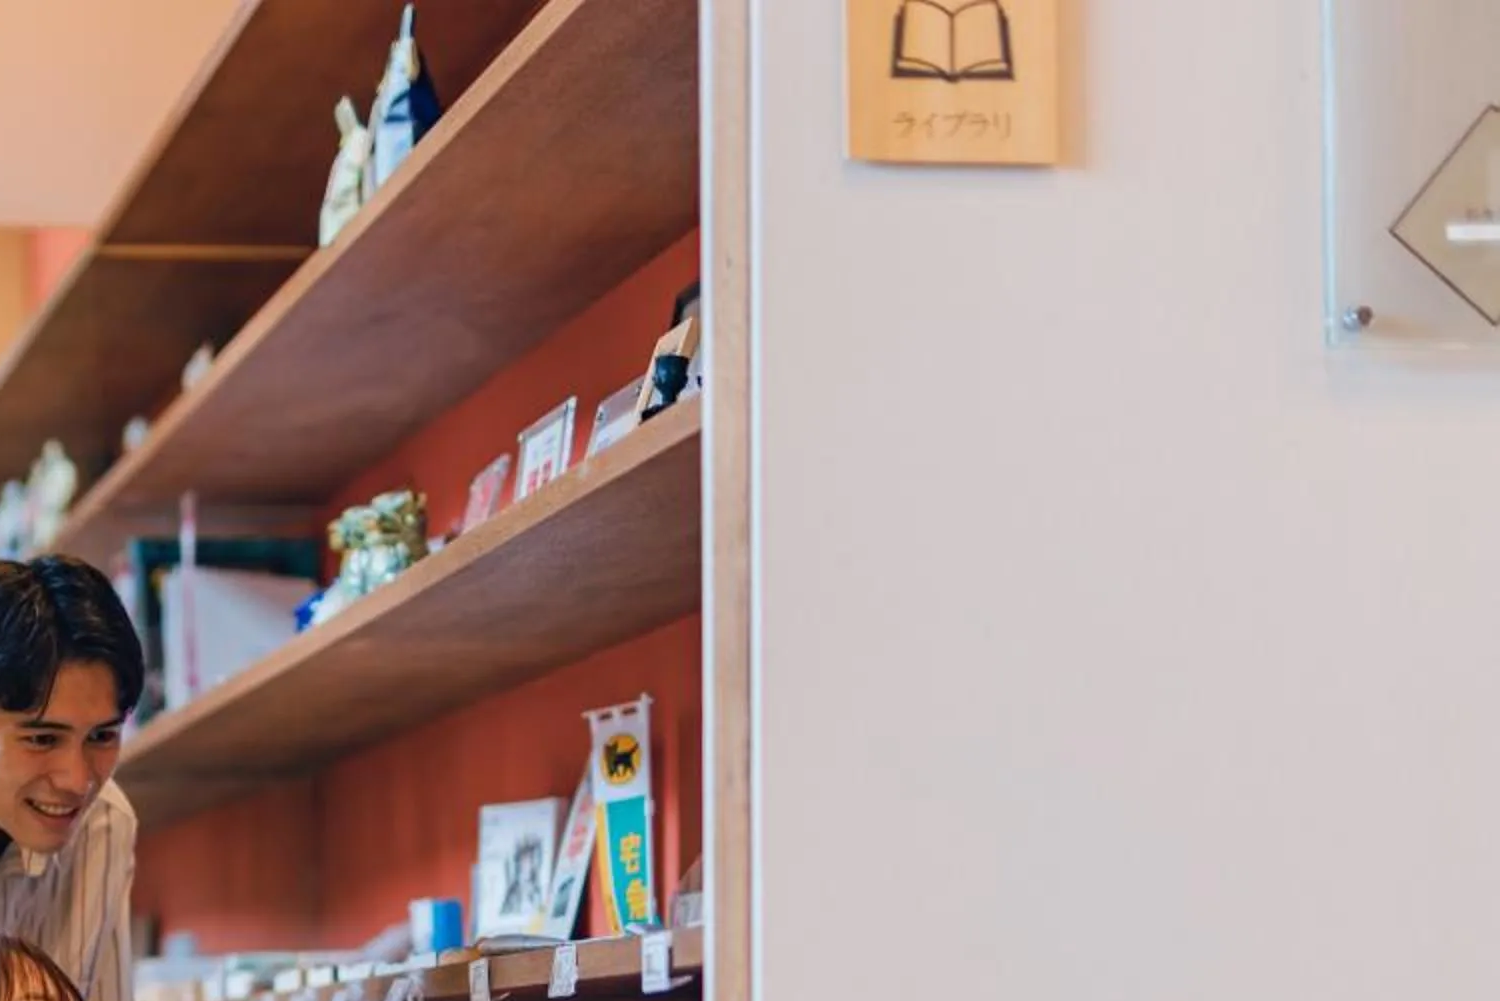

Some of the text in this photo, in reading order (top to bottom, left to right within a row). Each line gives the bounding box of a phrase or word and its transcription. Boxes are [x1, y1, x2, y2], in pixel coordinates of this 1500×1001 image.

[891, 109, 1012, 140] ライブラリ
